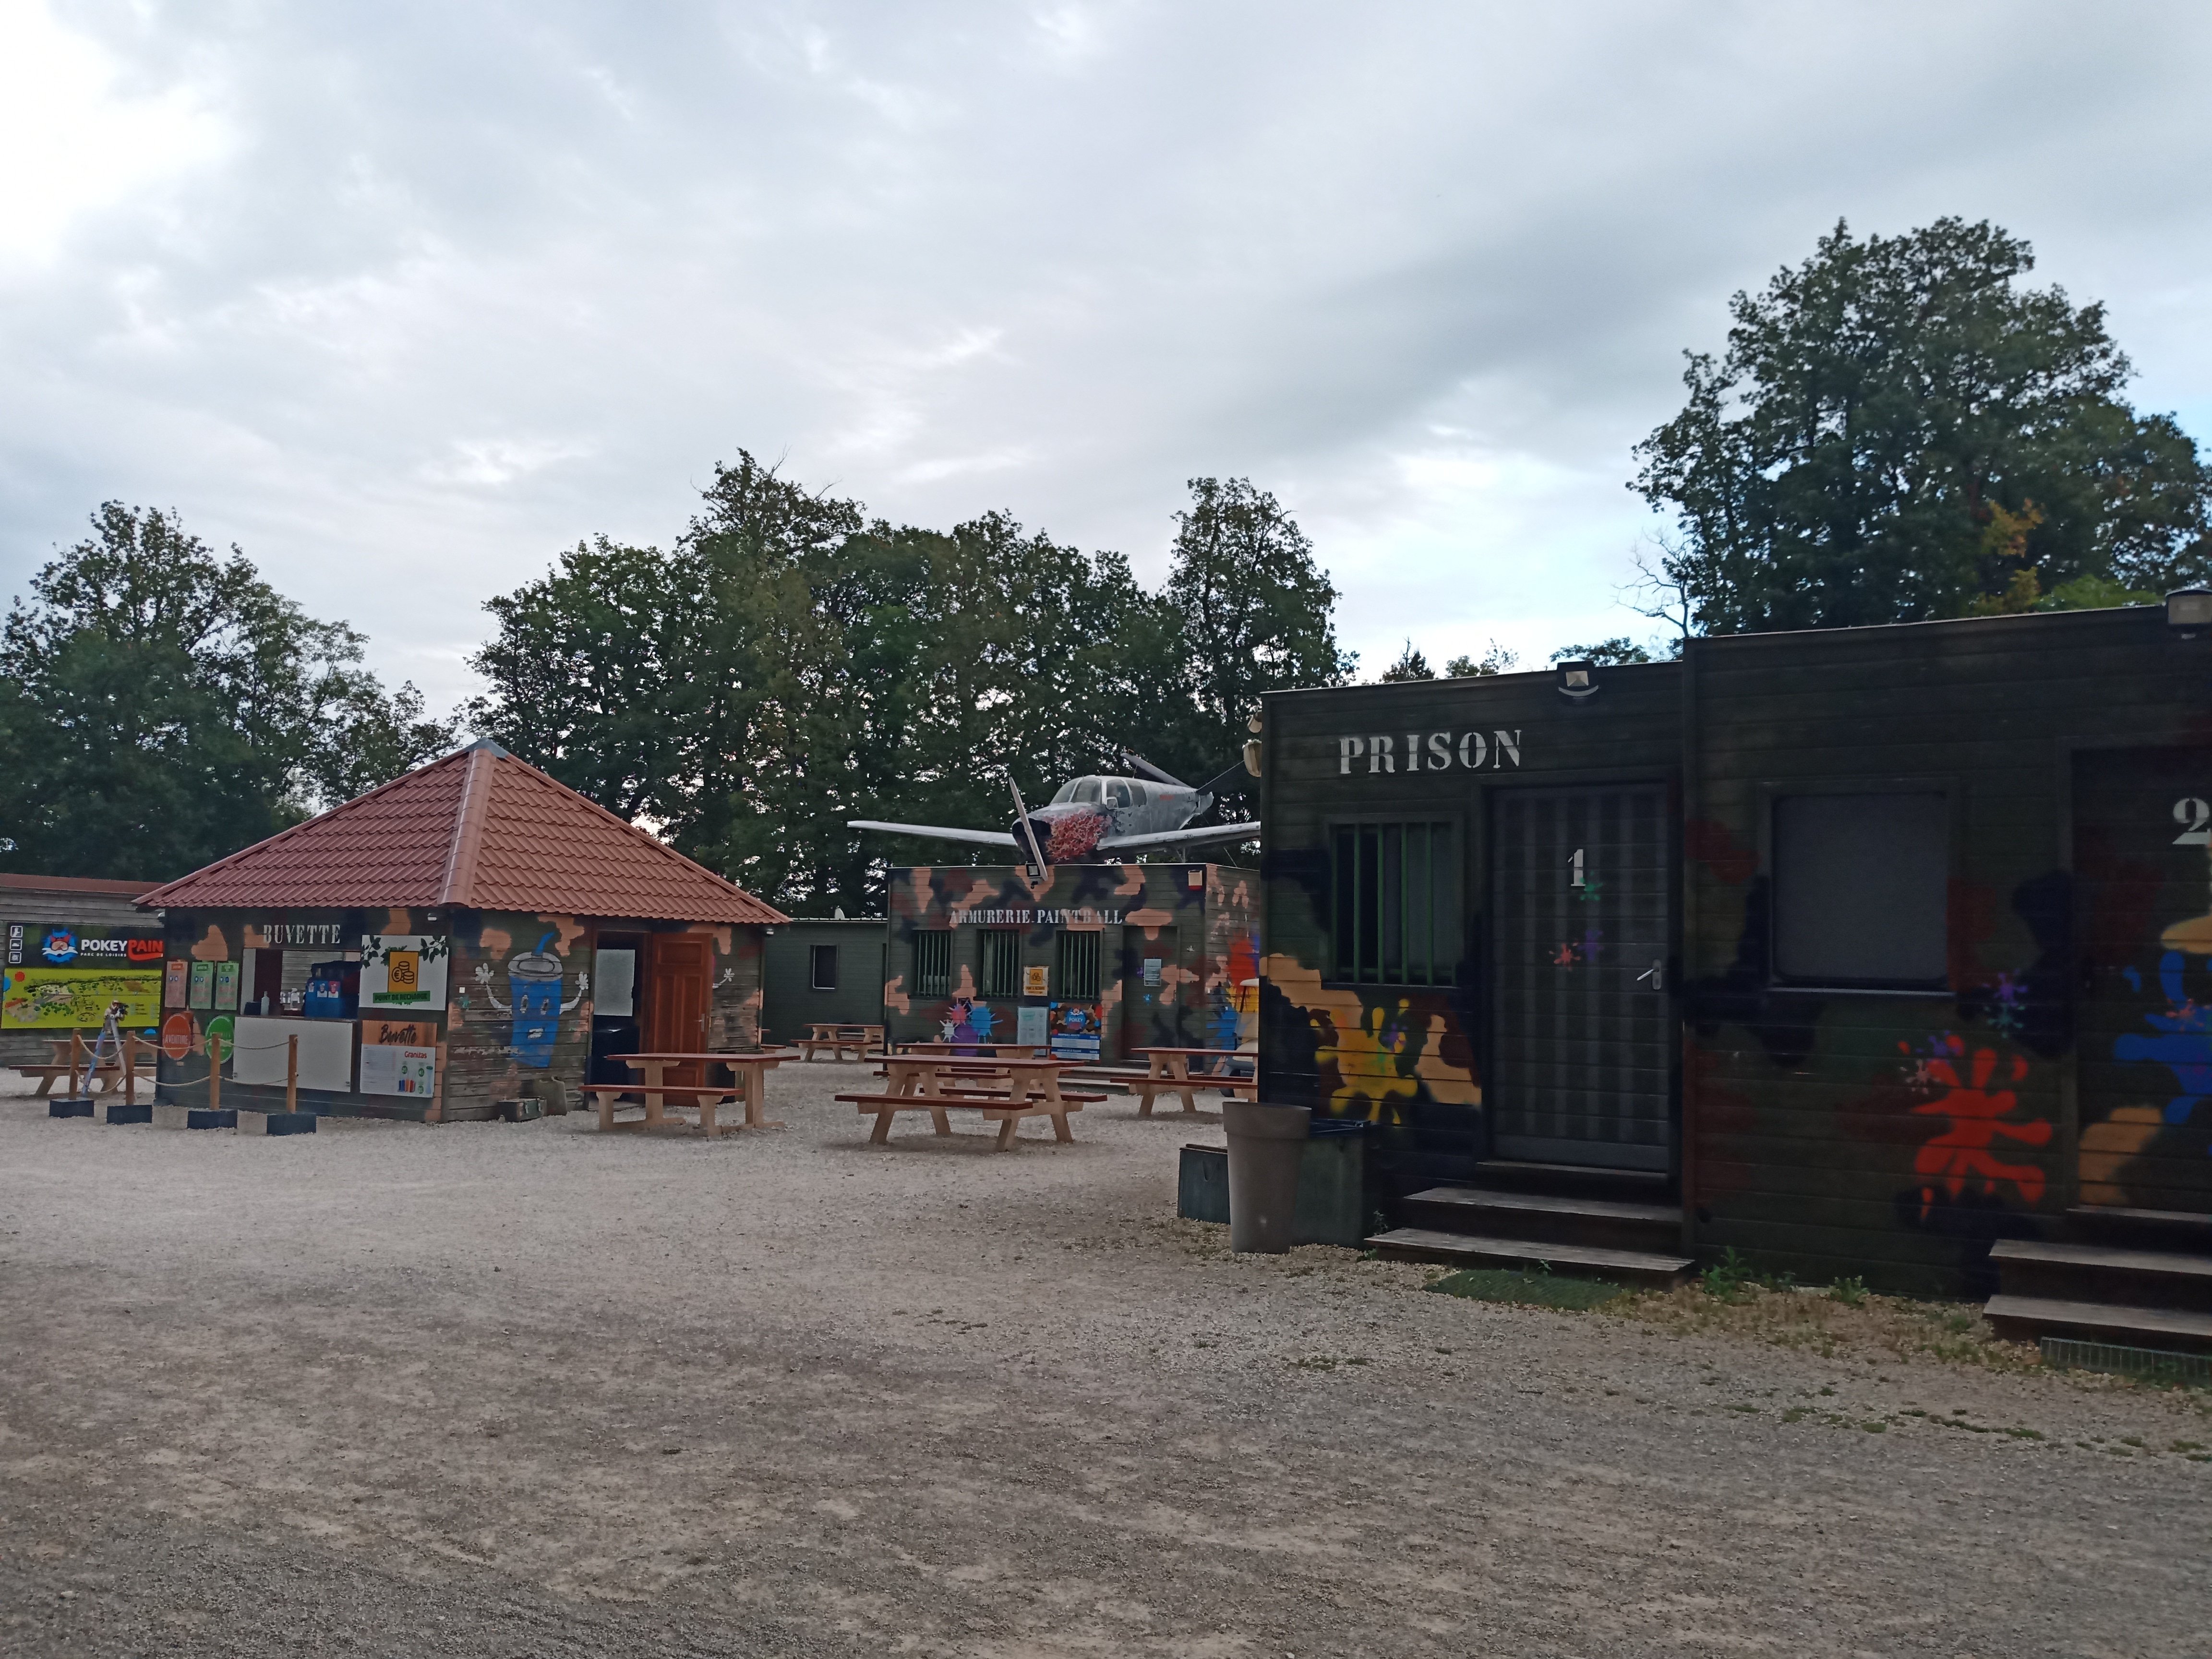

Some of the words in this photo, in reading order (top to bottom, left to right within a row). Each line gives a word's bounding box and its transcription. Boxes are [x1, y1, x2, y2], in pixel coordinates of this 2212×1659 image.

[1339, 730, 1522, 774] PRISON
[2172, 798, 2211, 845] 2
[1567, 849, 1586, 887] 1
[1037, 909, 1122, 925] PAINTBALL
[263, 925, 340, 944] BUVETTE
[81, 939, 128, 951] POKEY
[128, 939, 164, 960] PAIN
[165, 1034, 188, 1044] AVENTURE
[379, 1024, 417, 1046] Buvette
